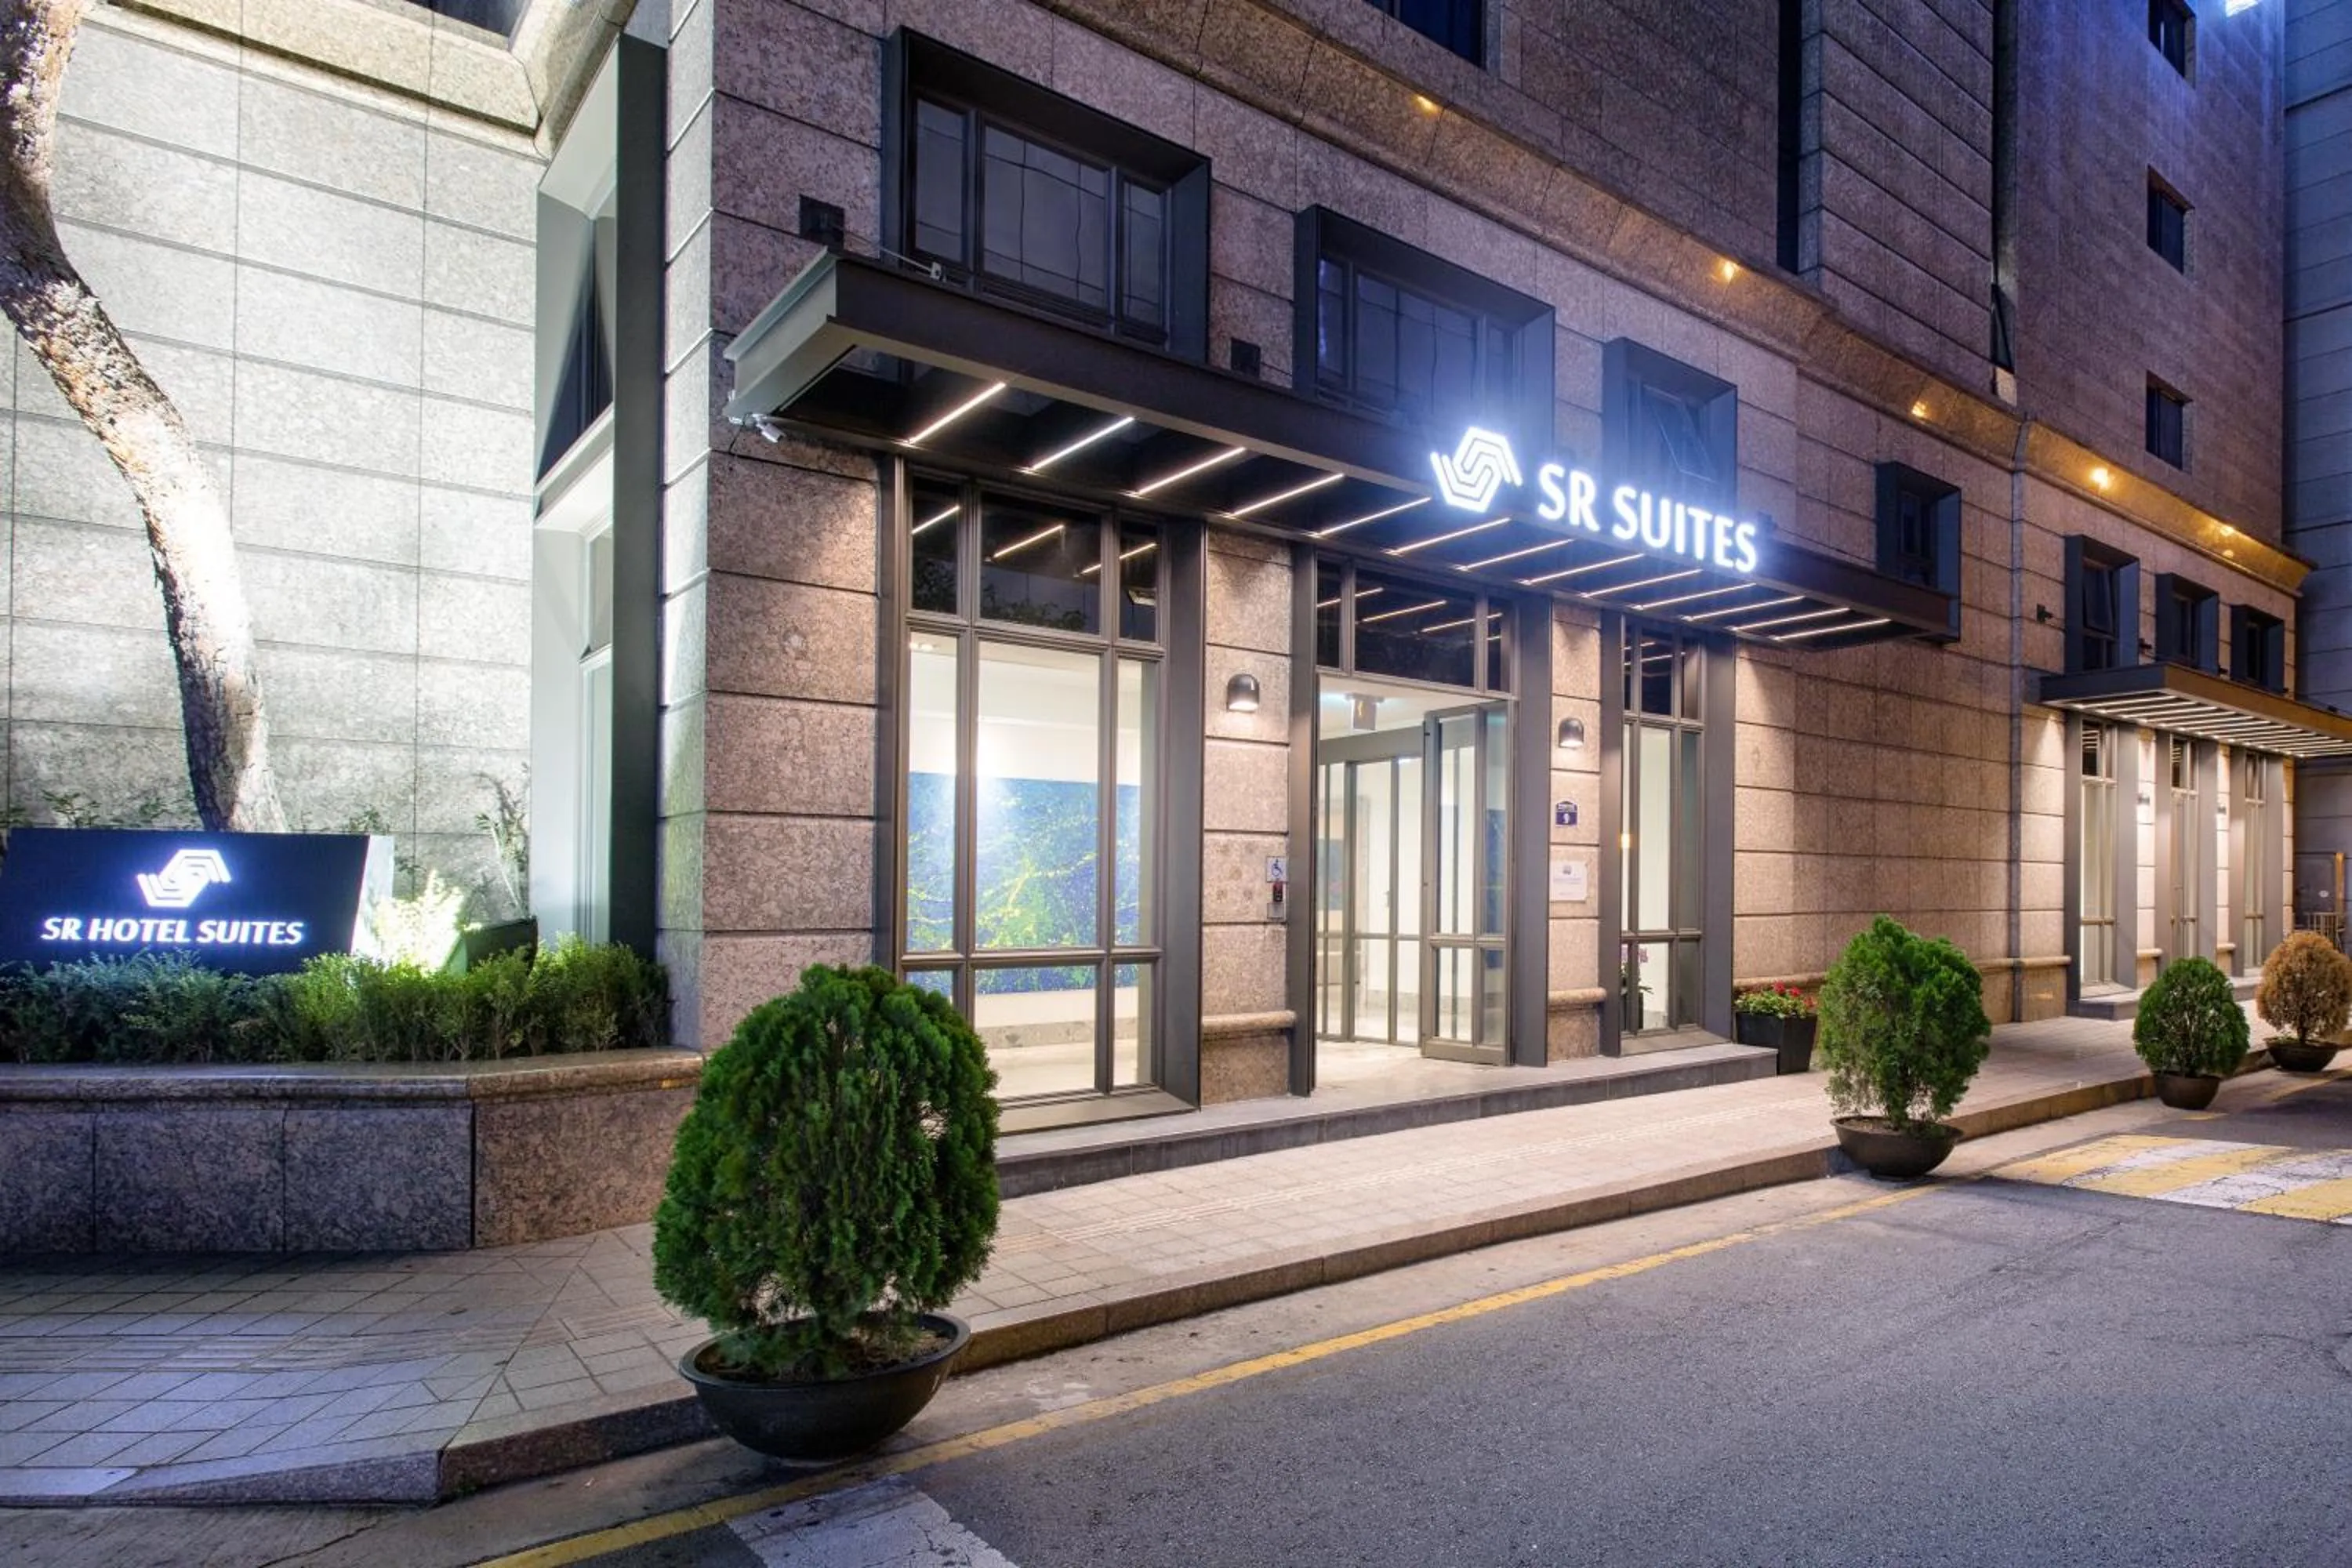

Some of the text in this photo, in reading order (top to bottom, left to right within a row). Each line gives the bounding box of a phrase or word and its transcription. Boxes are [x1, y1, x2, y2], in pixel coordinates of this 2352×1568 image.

[1537, 463, 1758, 573] SR SUITES
[42, 917, 303, 945] SR HOTEL SUITES
